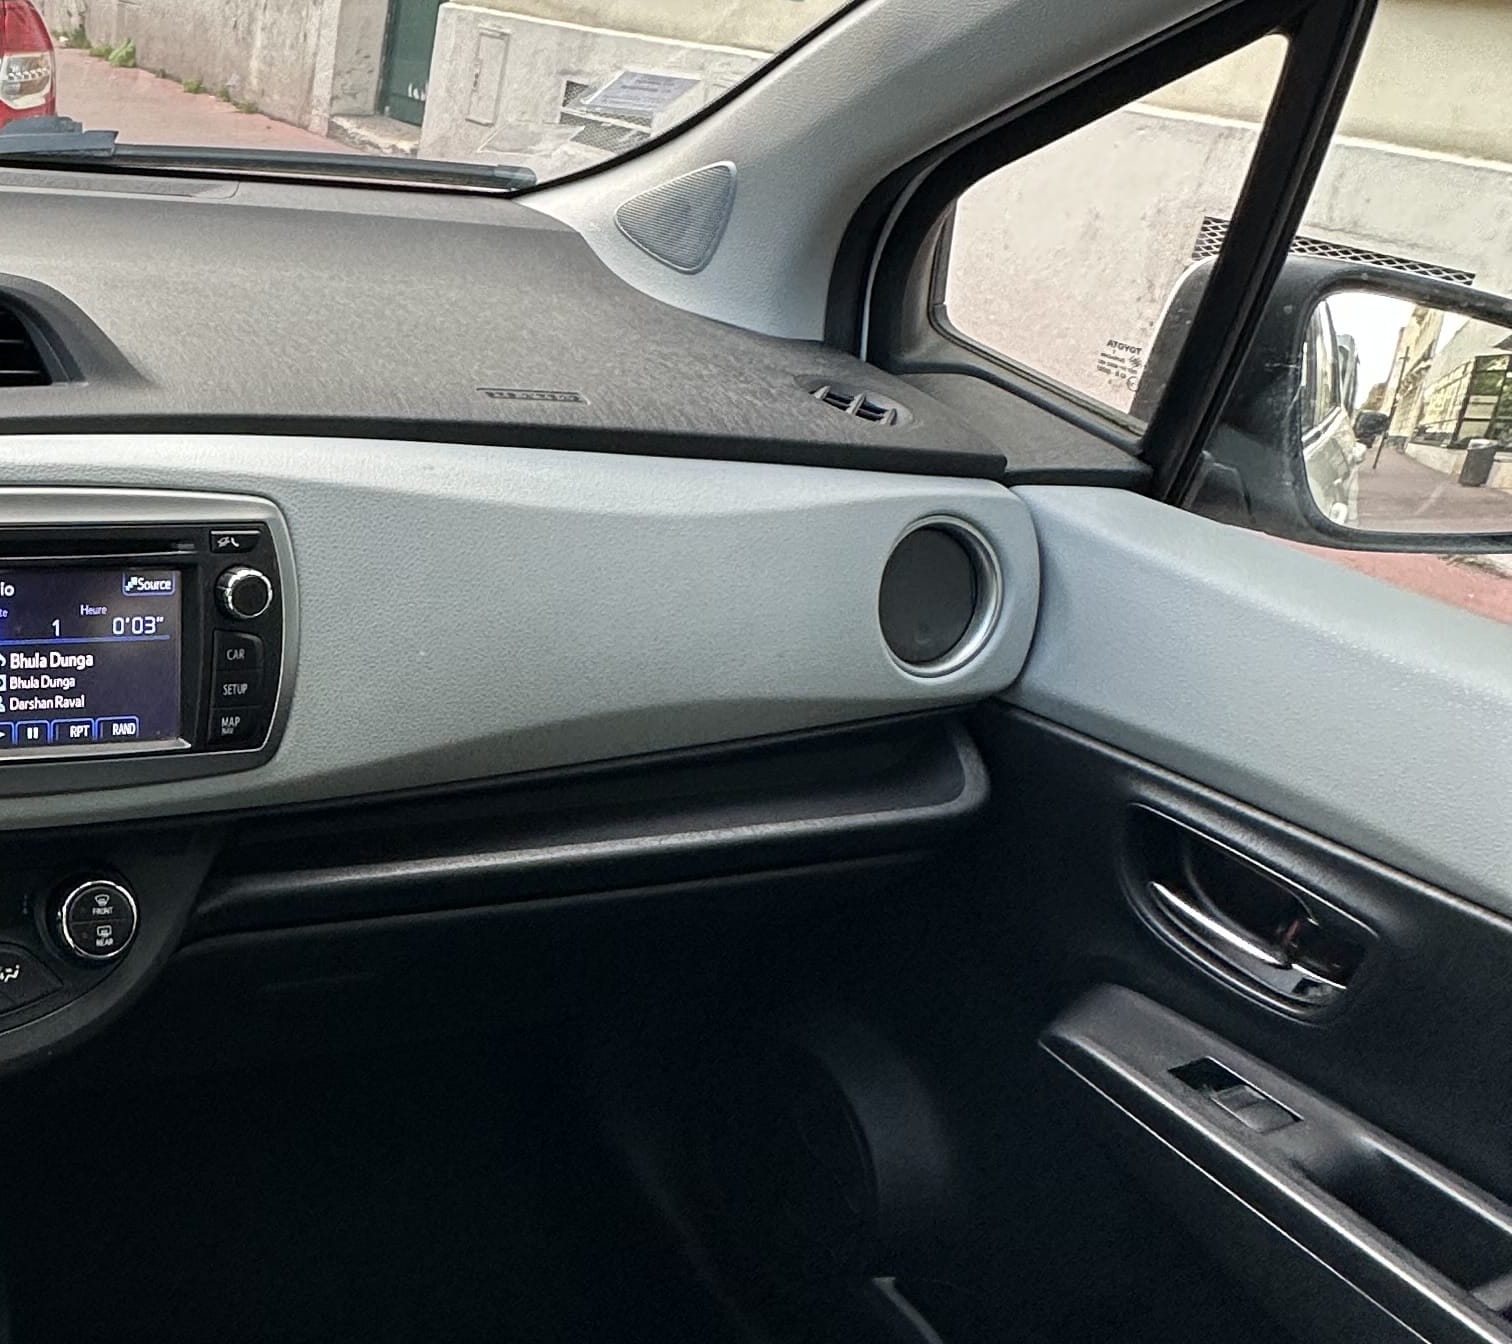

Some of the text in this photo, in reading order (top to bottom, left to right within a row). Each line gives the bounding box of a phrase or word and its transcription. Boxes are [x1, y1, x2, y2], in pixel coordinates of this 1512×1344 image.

[137, 577, 172, 593] Source
[80, 604, 108, 617] Heure
[51, 619, 61, 637] 1
[10, 651, 94, 671] Bhula Dunga
[226, 648, 245, 661] CAR
[9, 675, 76, 691] Bhula Dunga
[222, 683, 248, 696] SETUP
[9, 694, 86, 711] Darshan Raval
[112, 721, 137, 736] RAND
[221, 716, 241, 727] MAP
[69, 723, 90, 738] RPT
